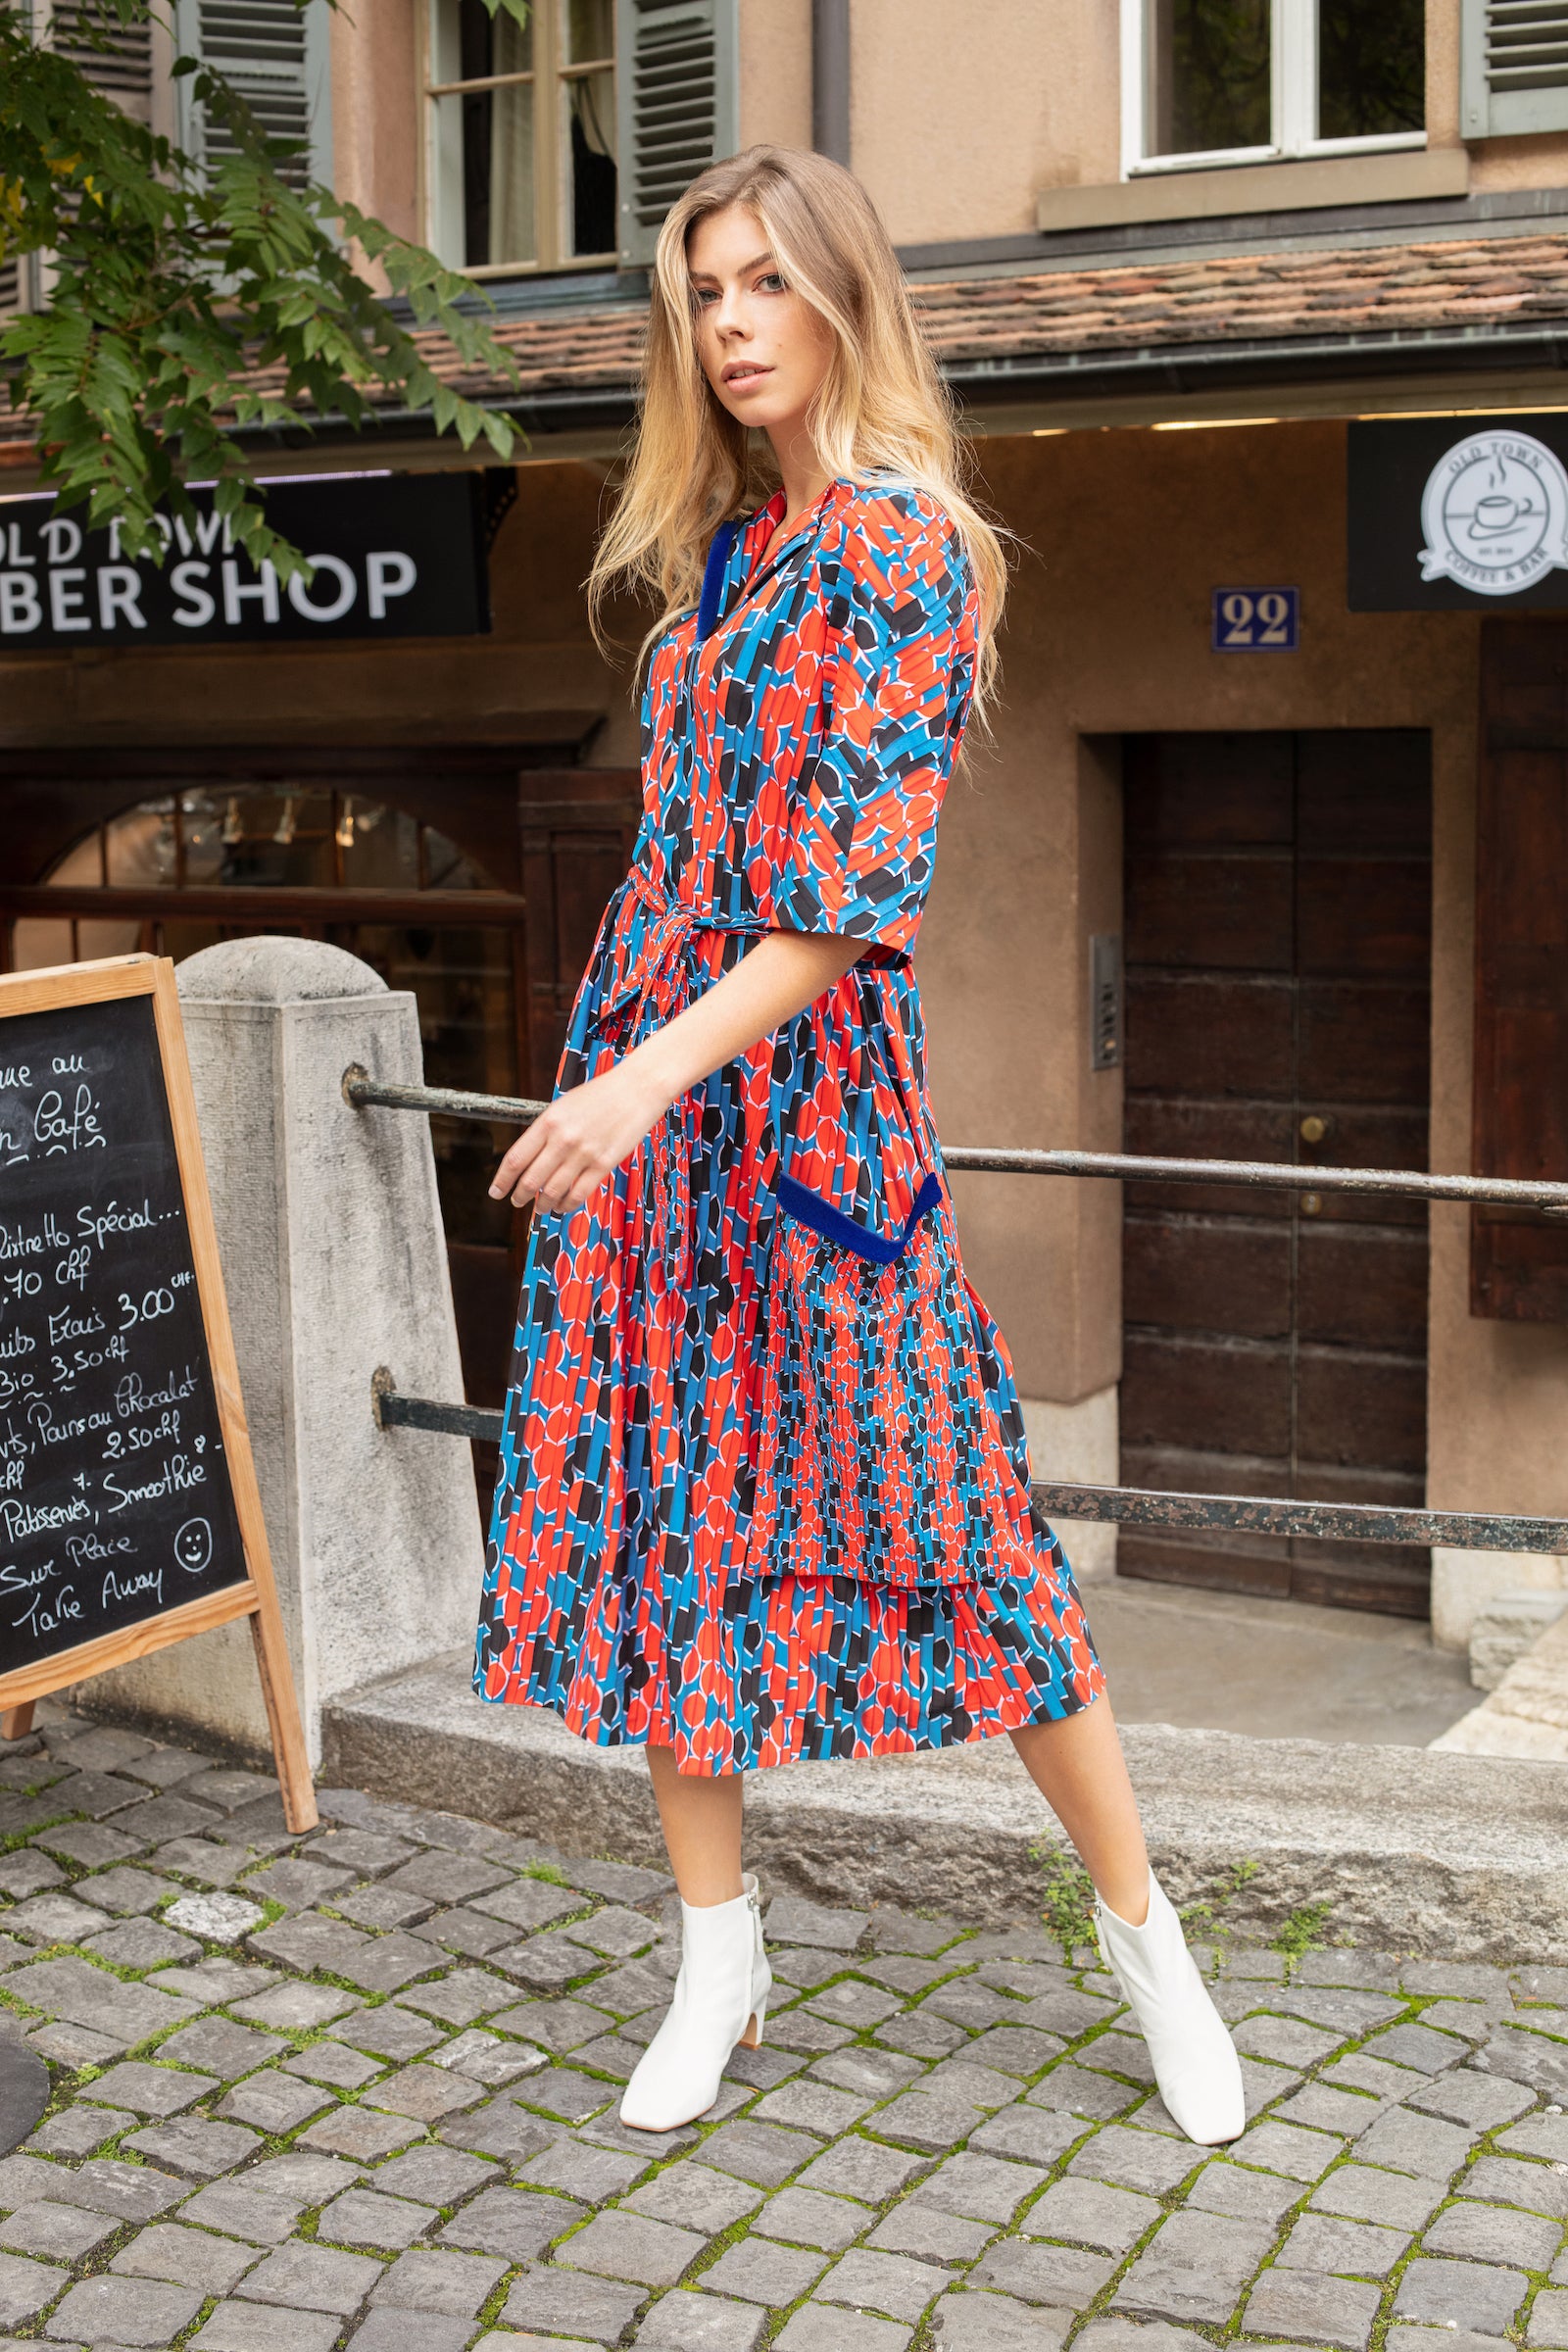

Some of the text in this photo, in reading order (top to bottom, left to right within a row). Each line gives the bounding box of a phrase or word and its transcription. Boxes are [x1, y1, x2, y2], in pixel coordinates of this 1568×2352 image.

[0, 517, 81, 566] LD
[1, 551, 417, 633] BER SHOP
[1222, 594, 1289, 644] 22
[52, 1054, 89, 1074] au
[34, 1084, 102, 1150] Café
[118, 1288, 174, 1331] 3.00
[0, 1533, 138, 1595] Sur Place
[12, 1568, 163, 1637] Take Away
